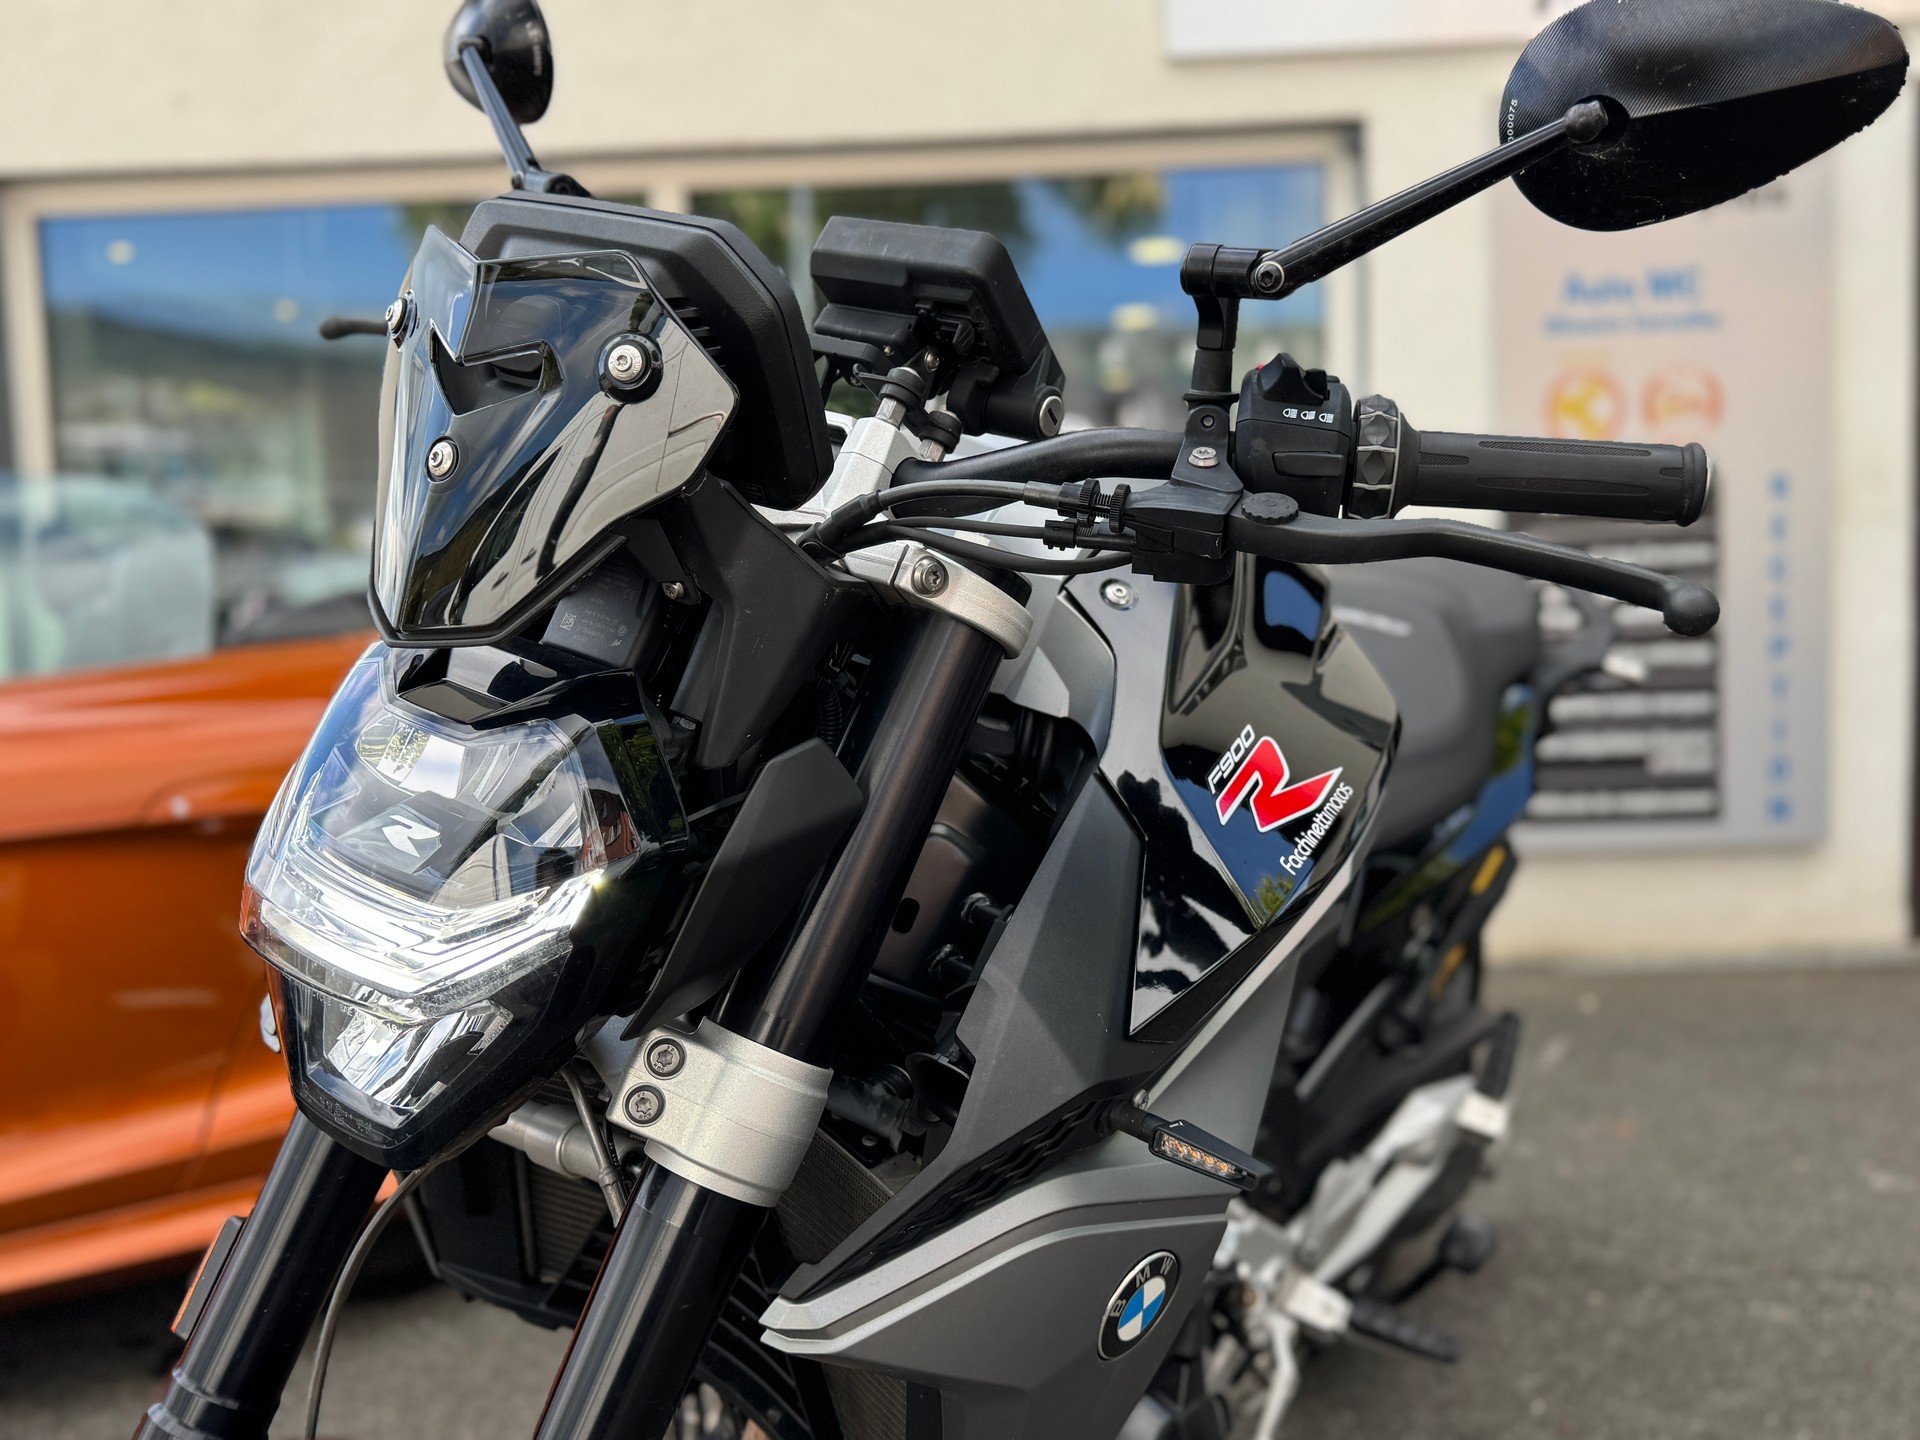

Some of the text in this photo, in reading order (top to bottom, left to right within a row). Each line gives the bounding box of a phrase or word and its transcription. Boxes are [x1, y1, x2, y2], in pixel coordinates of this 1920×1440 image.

[1208, 724, 1256, 795] F900
[1216, 736, 1344, 833] R
[1109, 1256, 1174, 1317] BMW
